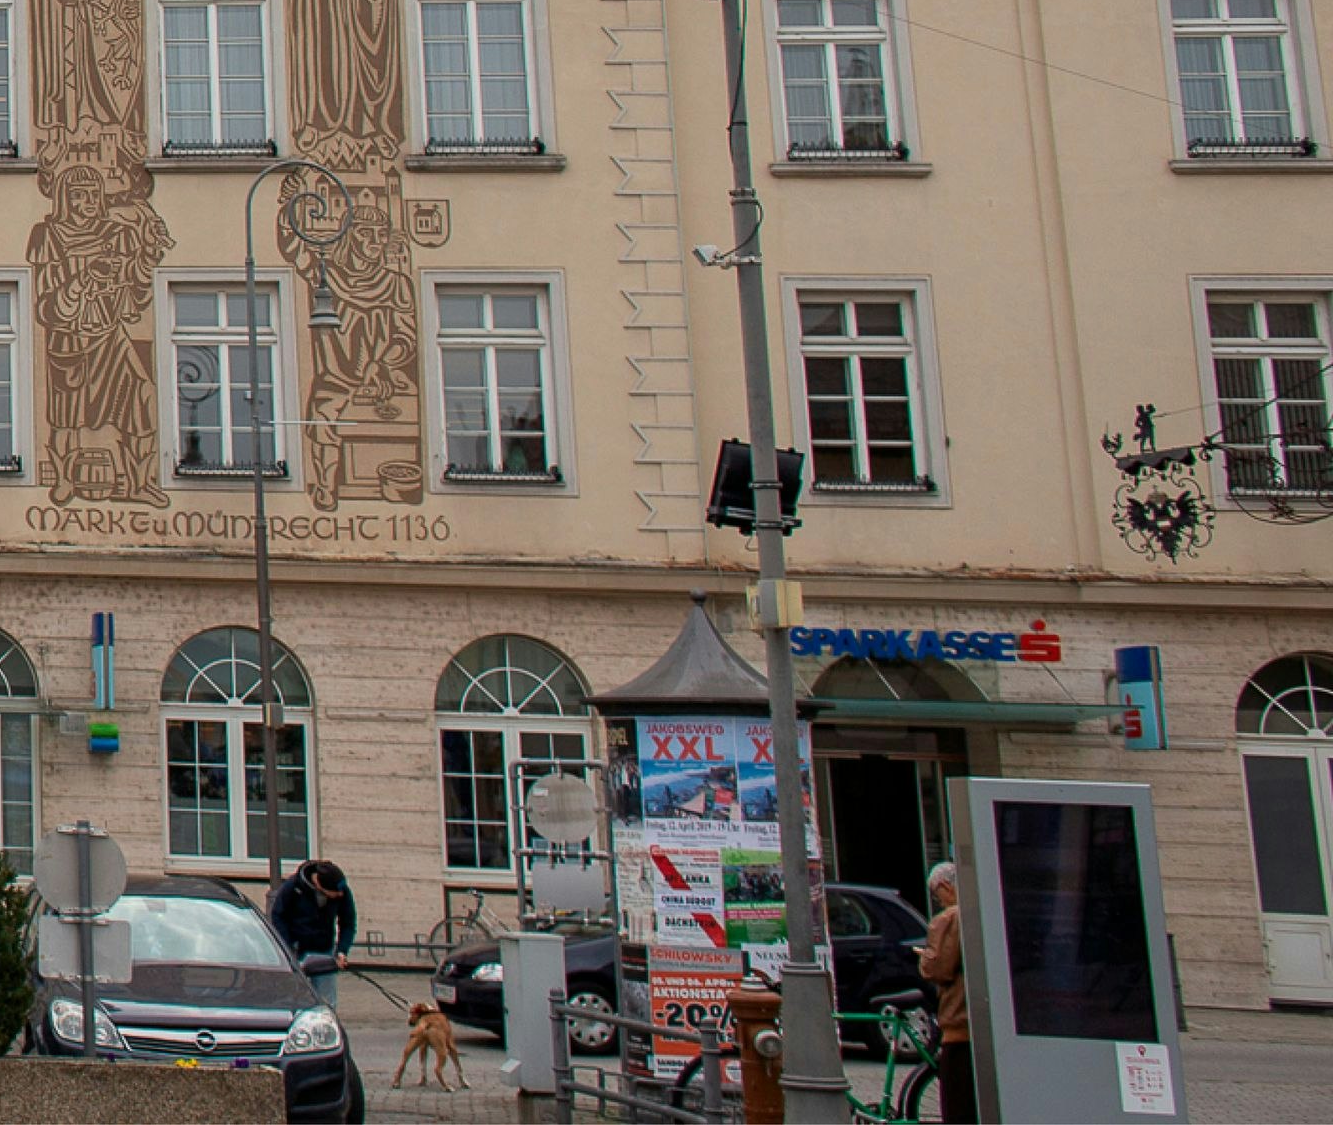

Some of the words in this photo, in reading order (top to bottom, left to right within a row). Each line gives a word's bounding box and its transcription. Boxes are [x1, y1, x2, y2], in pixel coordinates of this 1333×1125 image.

[25, 504, 151, 535] MARKT
[173, 509, 380, 542] MÜNRECHT
[789, 626, 1017, 663] SPARKASSE
[645, 723, 725, 735] JAKOBSWEG
[651, 735, 726, 761] XXL
[651, 949, 733, 965] SCHILOWSKY
